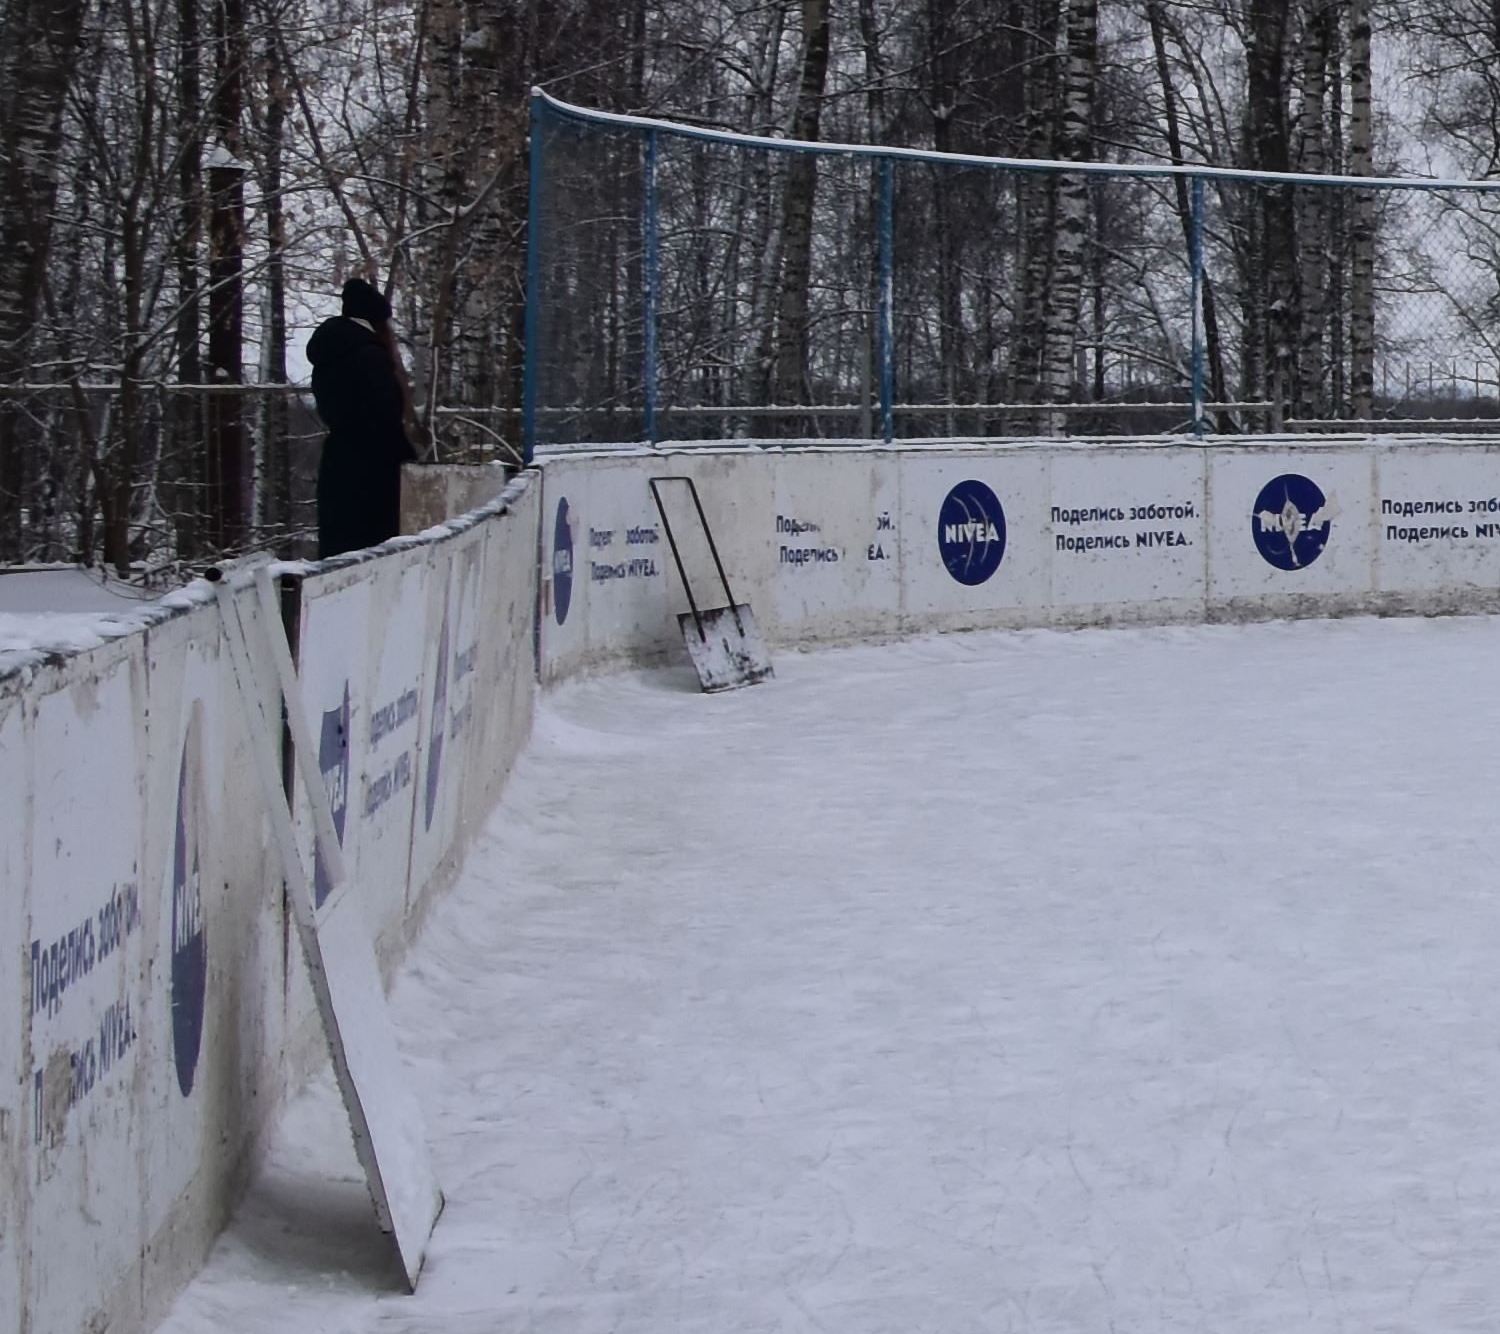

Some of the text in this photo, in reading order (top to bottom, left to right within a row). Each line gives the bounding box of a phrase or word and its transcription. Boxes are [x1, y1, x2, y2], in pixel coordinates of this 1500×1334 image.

[1051, 501, 1200, 525] Поделись заботой.
[1382, 499, 1463, 517] Поделись
[945, 520, 1000, 544] NIVEA
[1056, 531, 1193, 553] Поделись NIVEA.
[1387, 525, 1468, 543] Поделись
[31, 917, 95, 1020] Поделись
